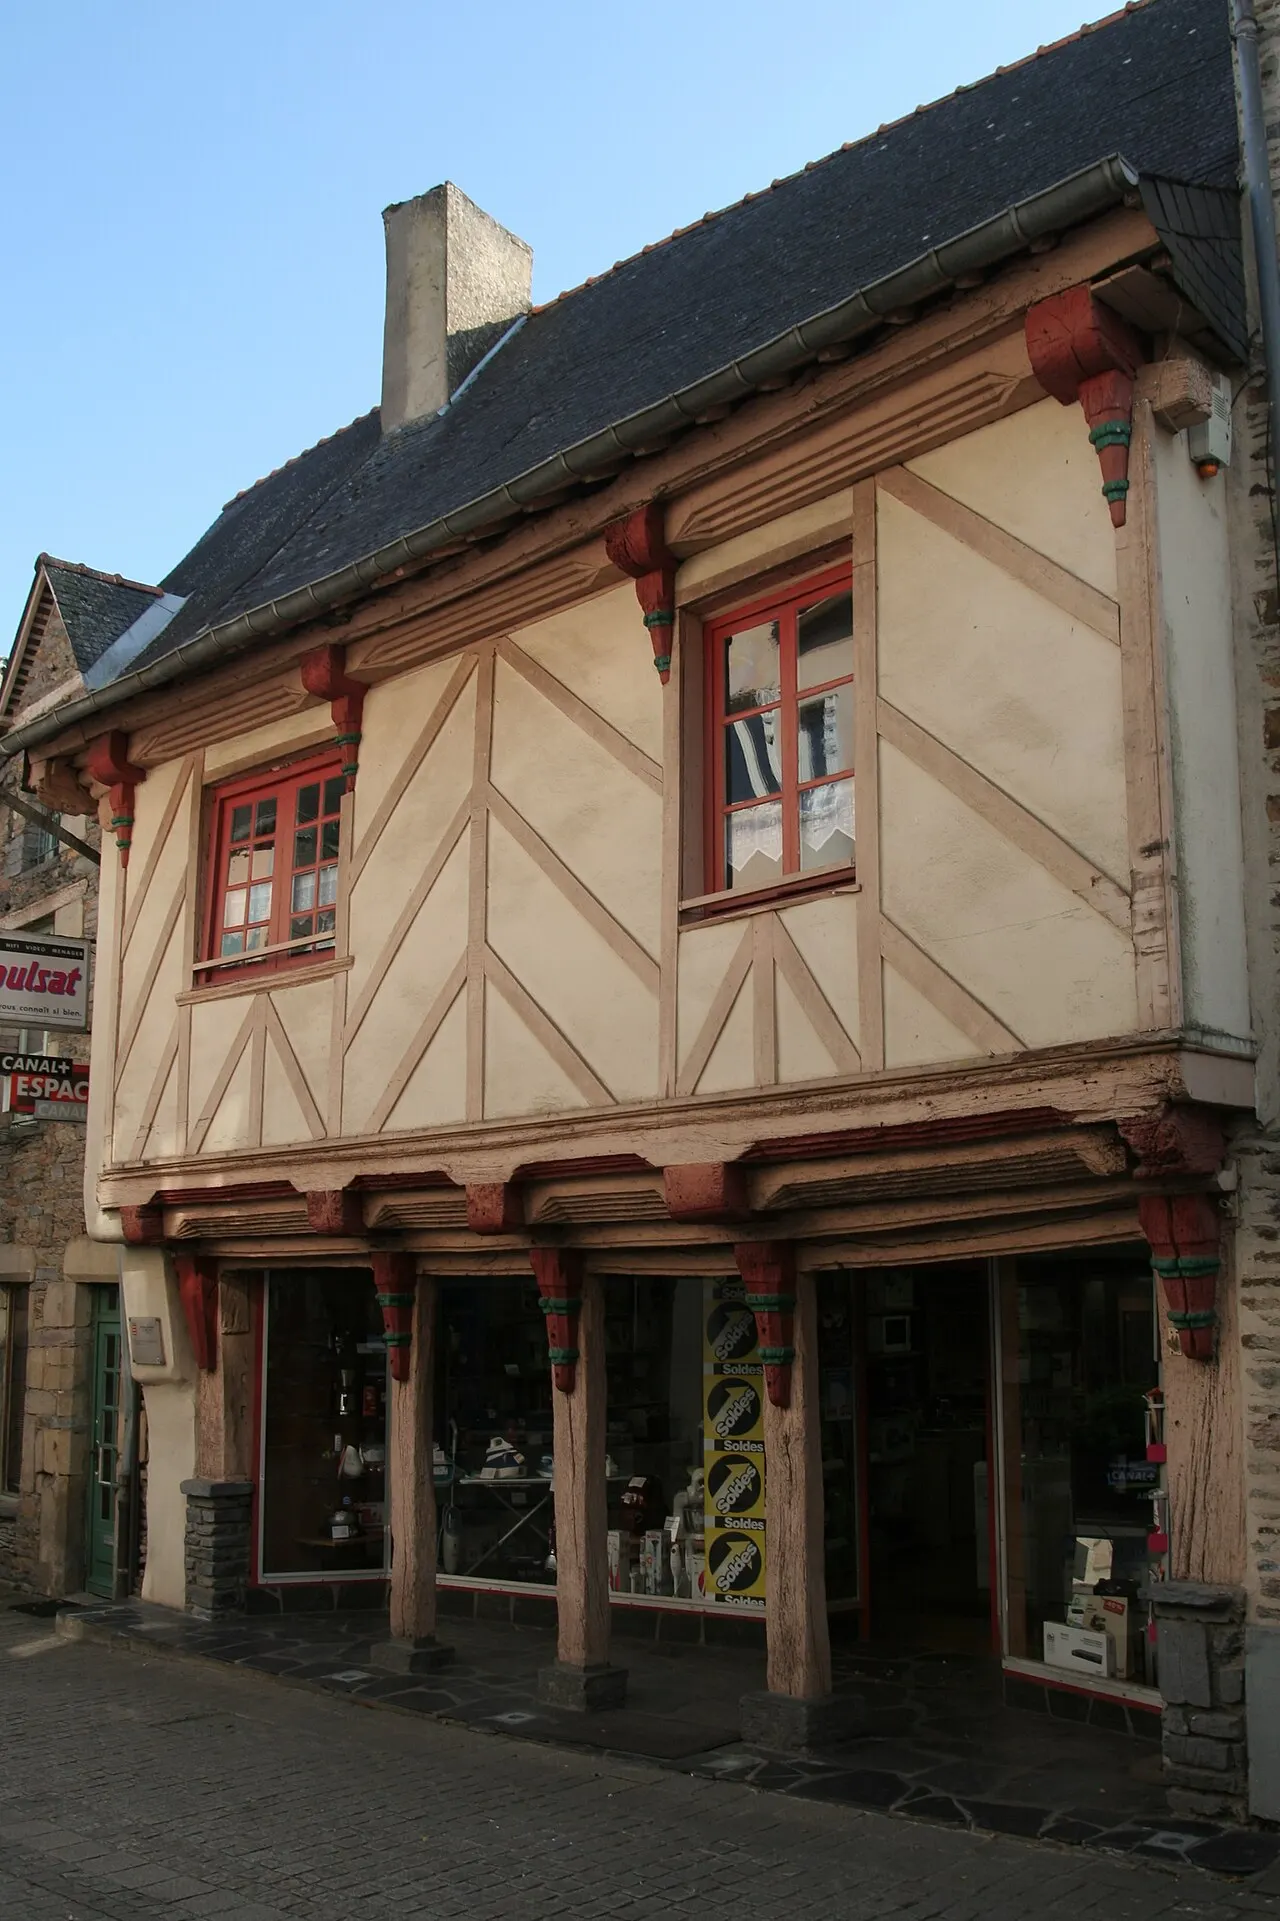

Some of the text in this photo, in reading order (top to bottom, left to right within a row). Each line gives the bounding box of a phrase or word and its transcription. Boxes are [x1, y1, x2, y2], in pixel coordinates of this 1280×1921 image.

[19, 1005, 49, 1014] connaît
[63, 1008, 82, 1017] bien.
[1, 1055, 70, 1074] CANAL+
[714, 1311, 755, 1361] Soldes
[722, 1363, 763, 1375] Soldes
[715, 1386, 756, 1438] Soldes
[723, 1439, 764, 1452] Soldes
[715, 1464, 757, 1515] Soldes
[724, 1516, 765, 1530] Soldes
[716, 1542, 758, 1592] Soldes
